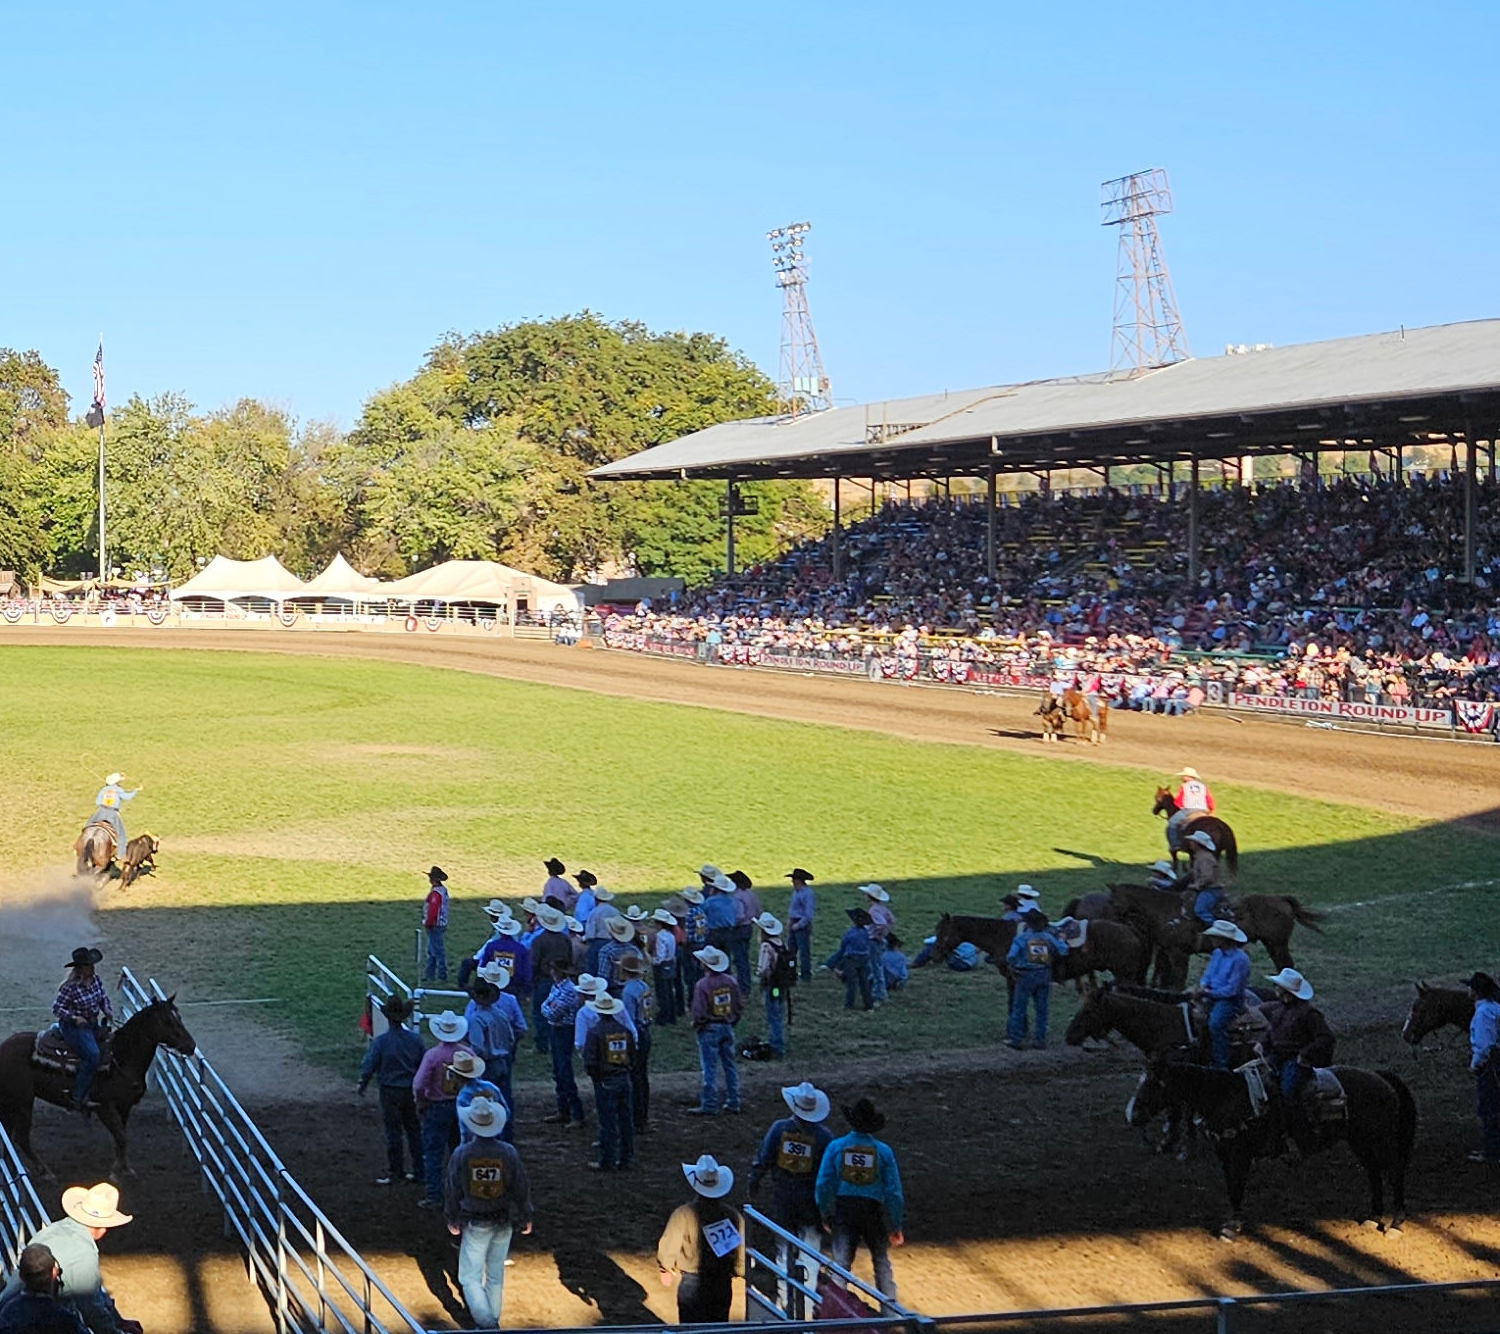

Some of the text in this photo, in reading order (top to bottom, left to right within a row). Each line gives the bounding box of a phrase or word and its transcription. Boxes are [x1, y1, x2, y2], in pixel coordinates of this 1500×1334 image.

[1234, 692, 1446, 722] PENDLETON ROUND-UP
[476, 1168, 497, 1180] 647
